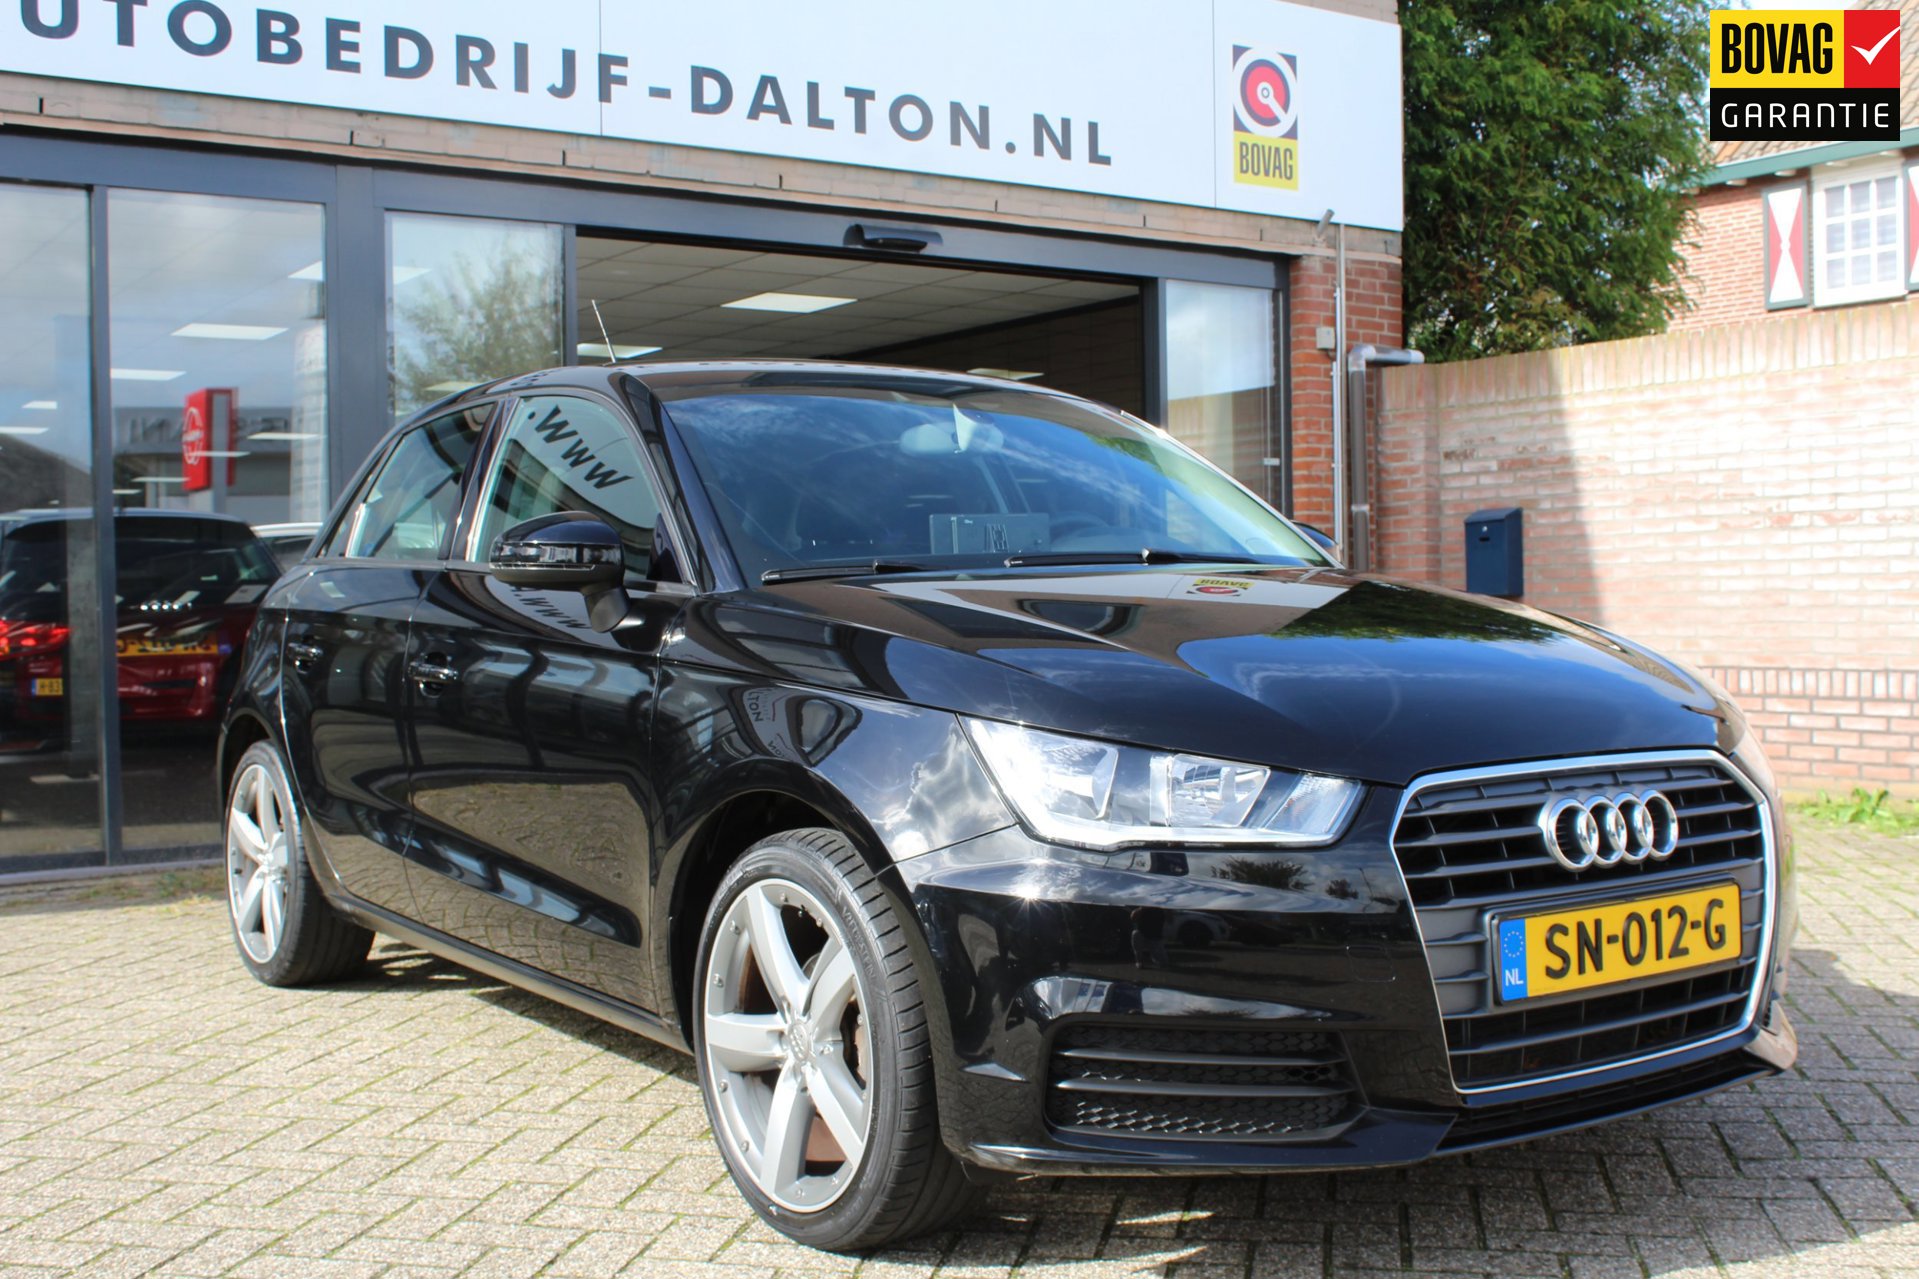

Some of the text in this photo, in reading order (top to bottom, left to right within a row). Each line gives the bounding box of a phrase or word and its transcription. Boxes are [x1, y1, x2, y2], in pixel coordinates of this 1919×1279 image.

[1239, 141, 1294, 181] BOVAG
[1545, 898, 1726, 980] SN-012-G
[1504, 968, 1524, 987] NL
